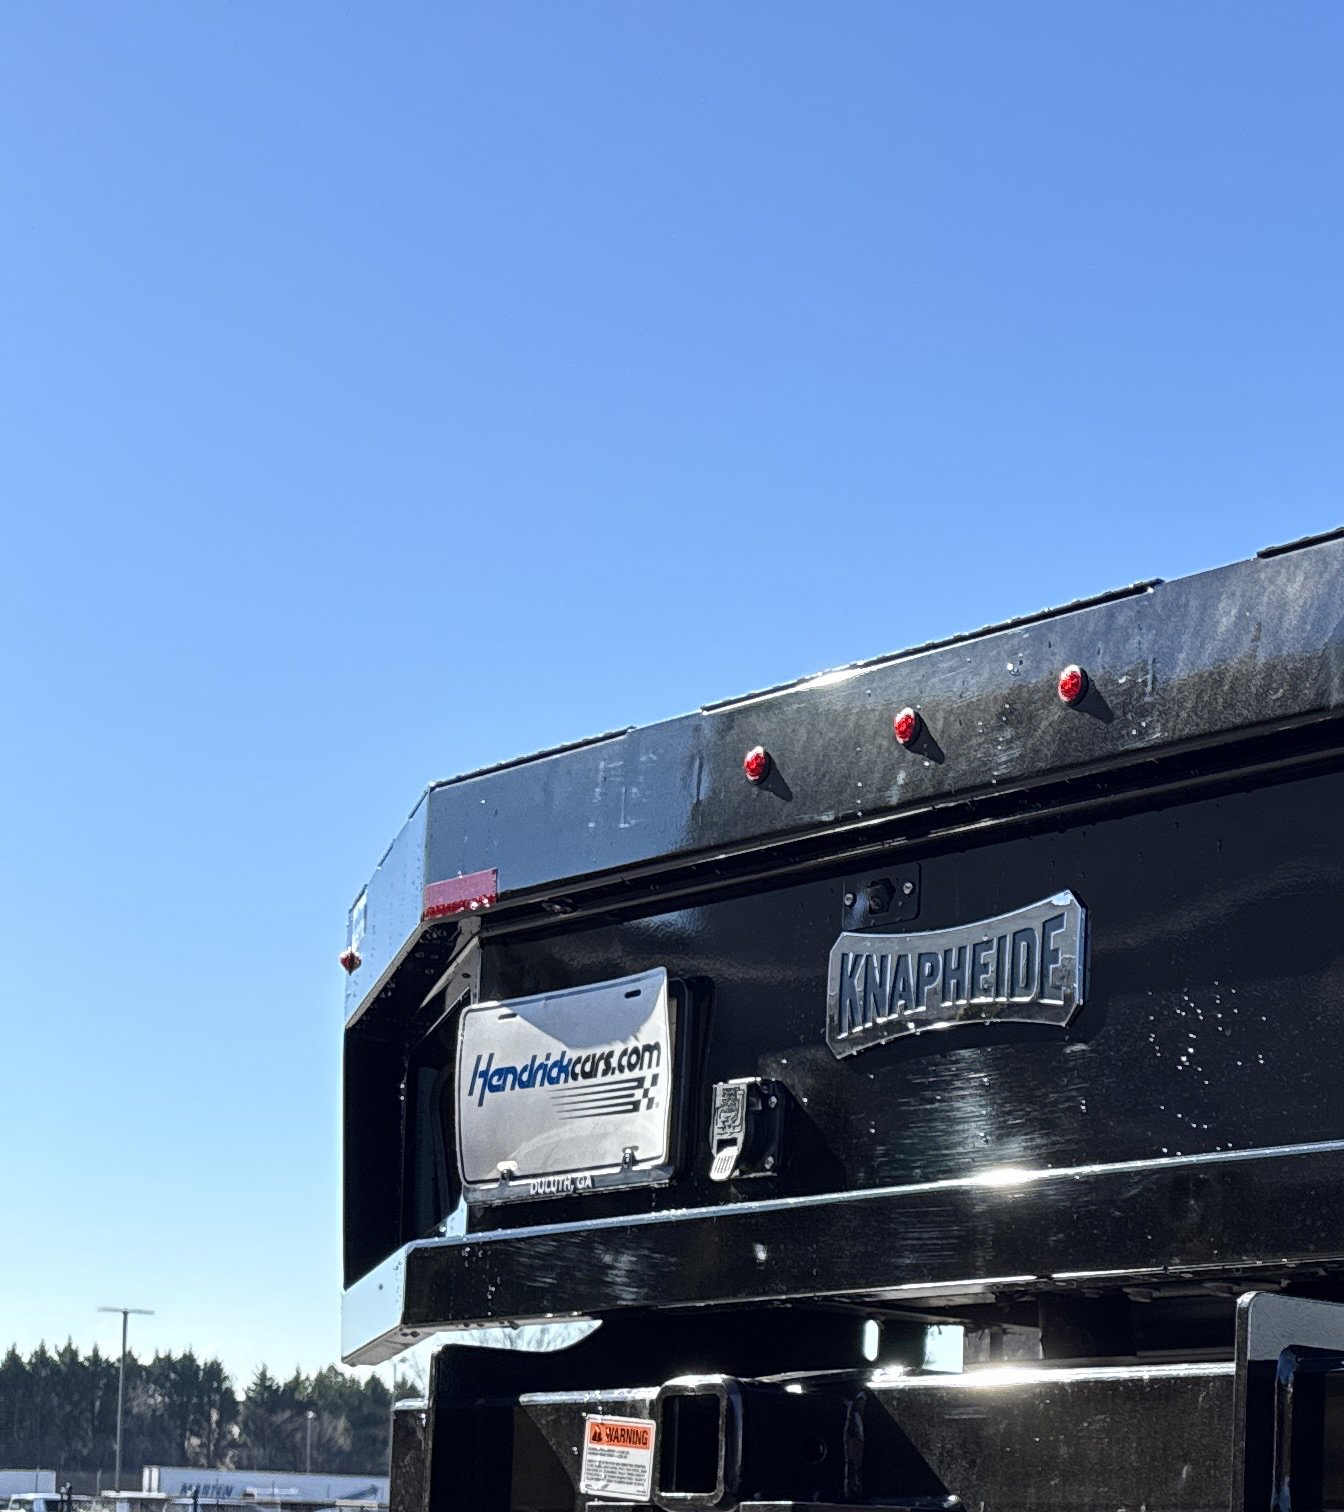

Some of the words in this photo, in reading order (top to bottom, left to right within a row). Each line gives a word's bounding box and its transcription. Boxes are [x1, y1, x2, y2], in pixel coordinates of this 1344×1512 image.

[837, 912, 1068, 1040] KNAPHEIDE
[468, 1041, 661, 1107] Hendrickcars.com
[605, 1426, 649, 1446] WARNING
